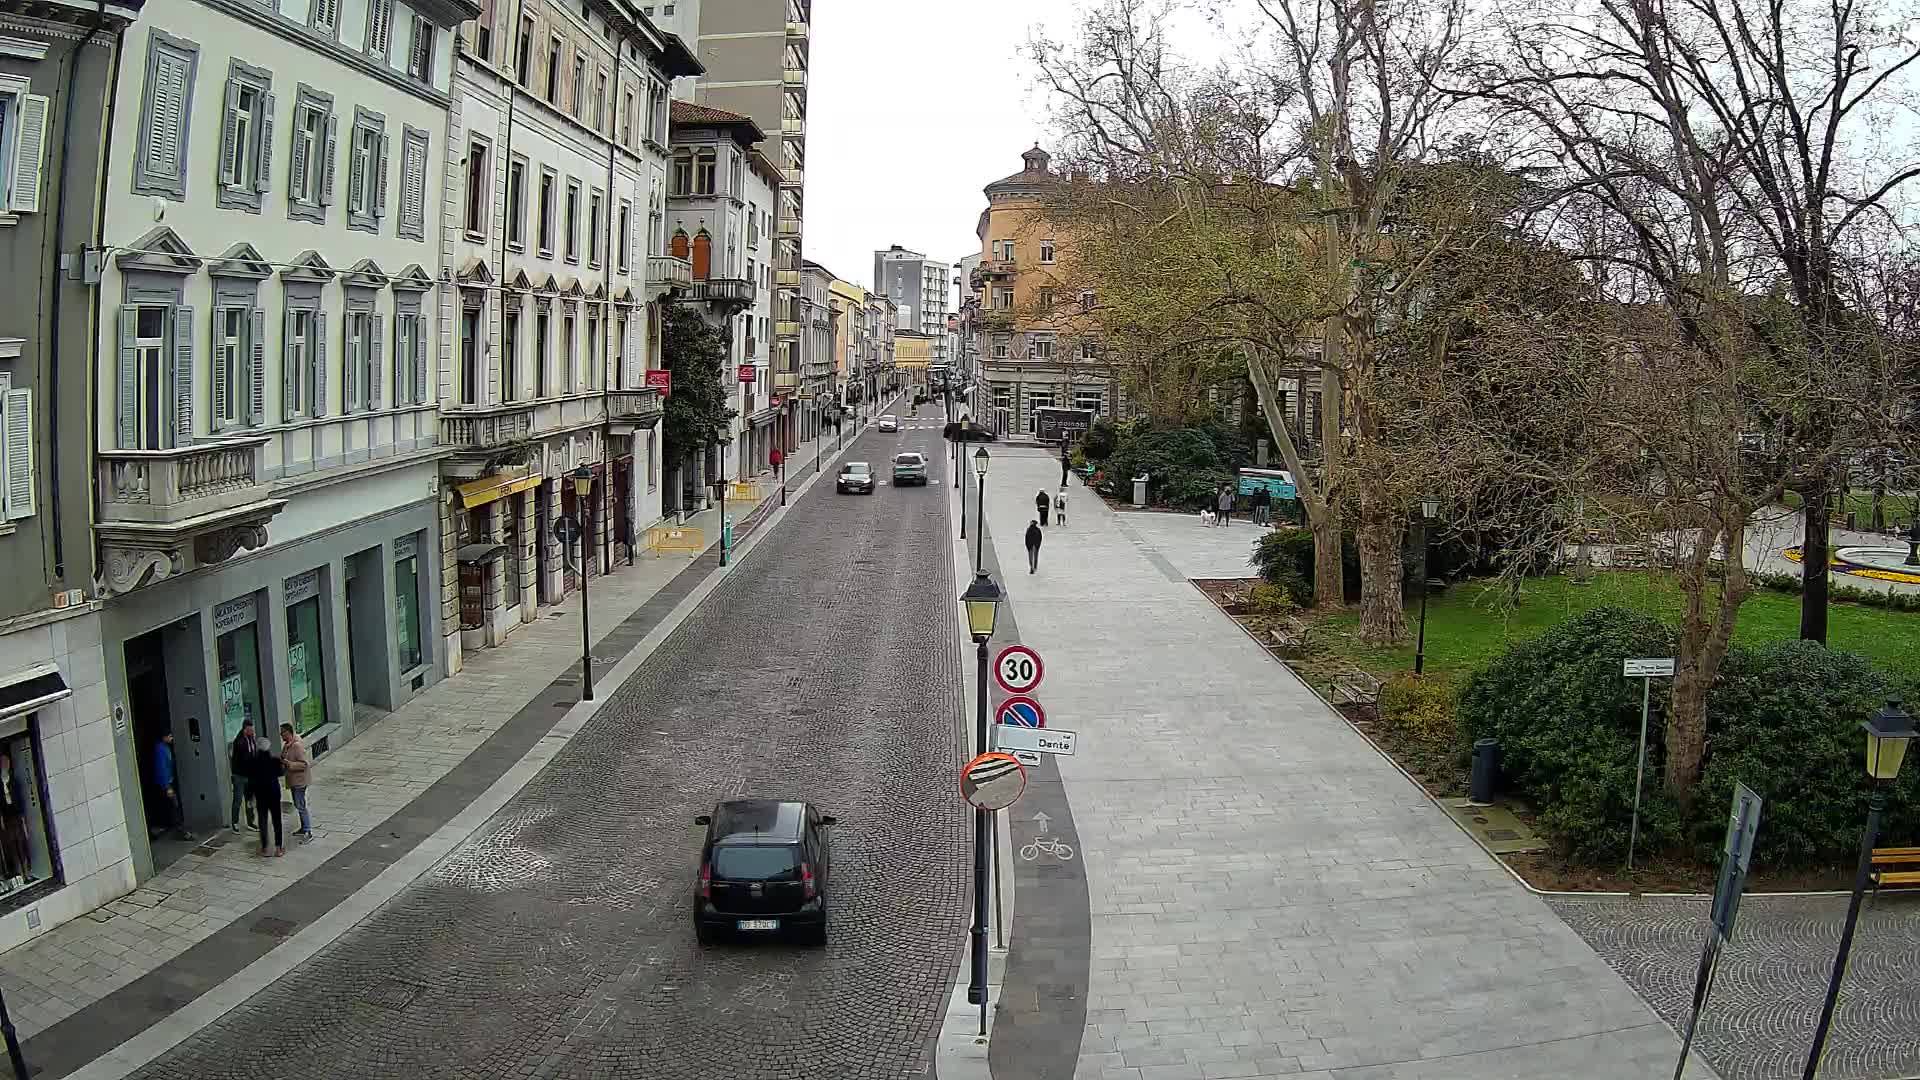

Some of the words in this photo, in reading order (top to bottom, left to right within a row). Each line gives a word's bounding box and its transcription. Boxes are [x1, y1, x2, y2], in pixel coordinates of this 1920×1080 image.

[289, 646, 304, 667] 130
[1005, 659, 1032, 680] 30
[222, 678, 241, 702] 130
[1039, 739, 1069, 749] Dante
